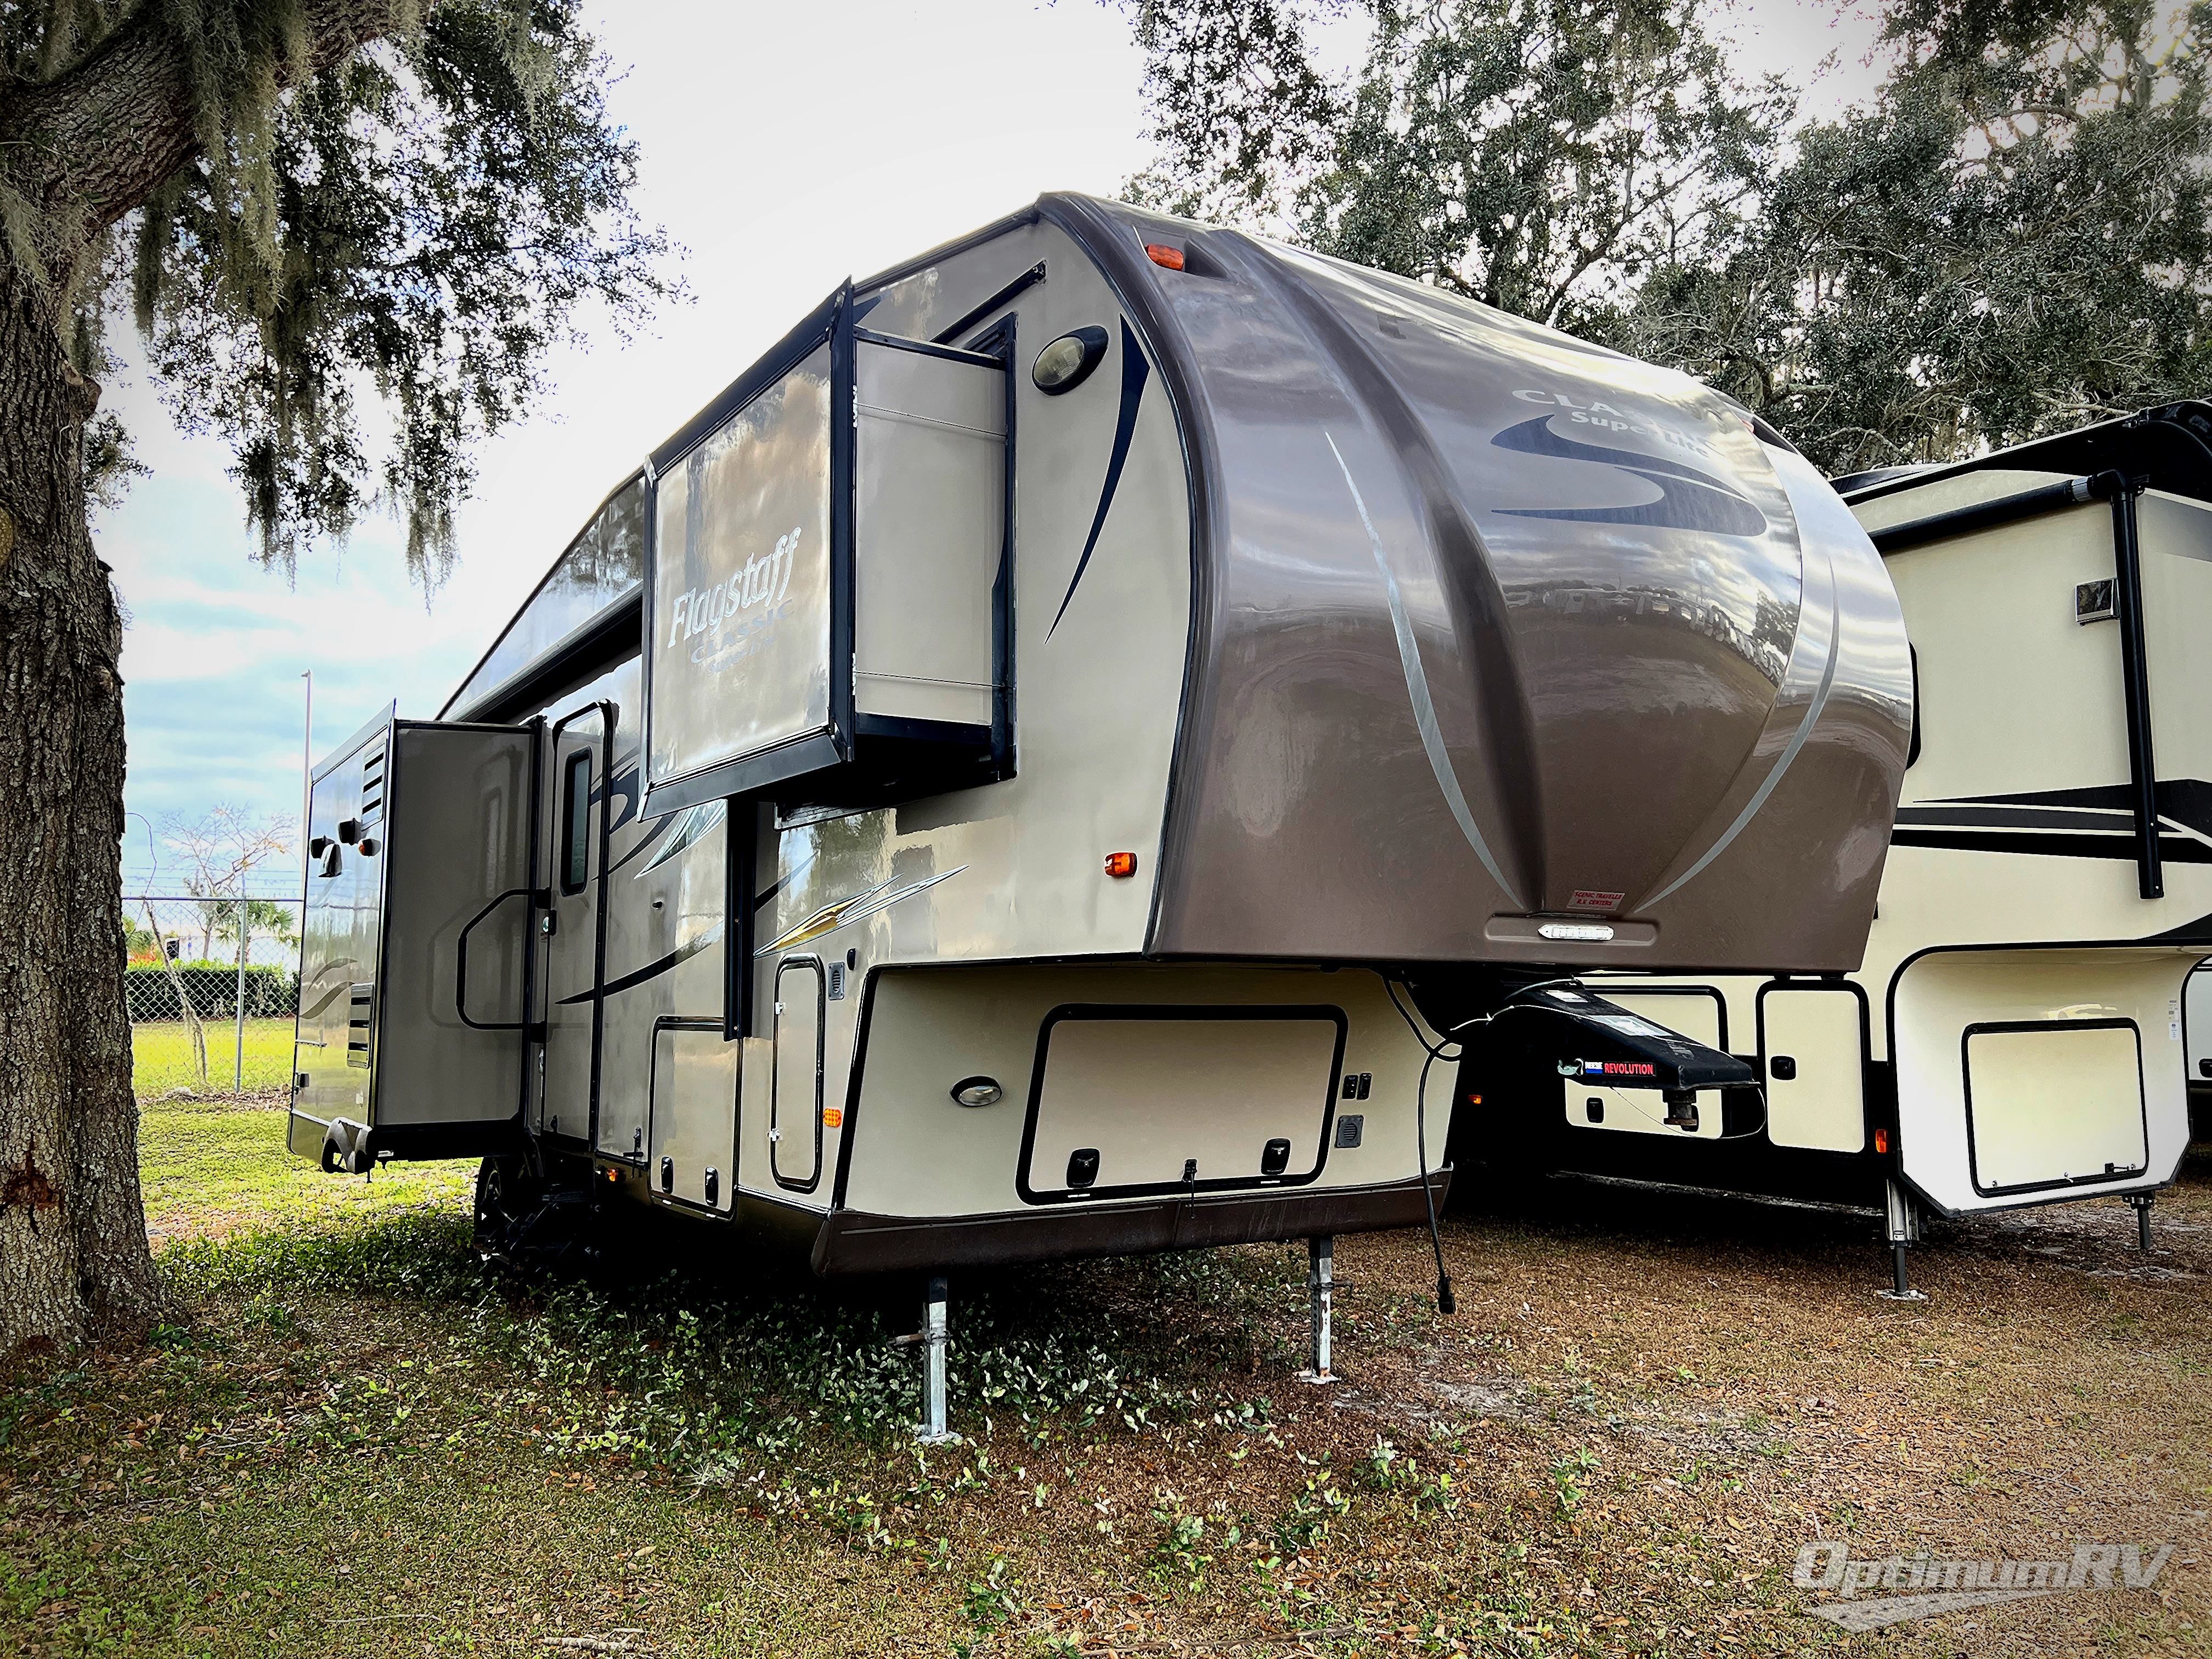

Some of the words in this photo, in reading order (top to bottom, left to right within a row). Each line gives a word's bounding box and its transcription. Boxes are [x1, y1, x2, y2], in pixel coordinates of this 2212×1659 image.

[667, 526, 801, 648] Flagstaff
[691, 598, 795, 664] CLASSIC
[1604, 1063, 1654, 1075] REVOLUTION
